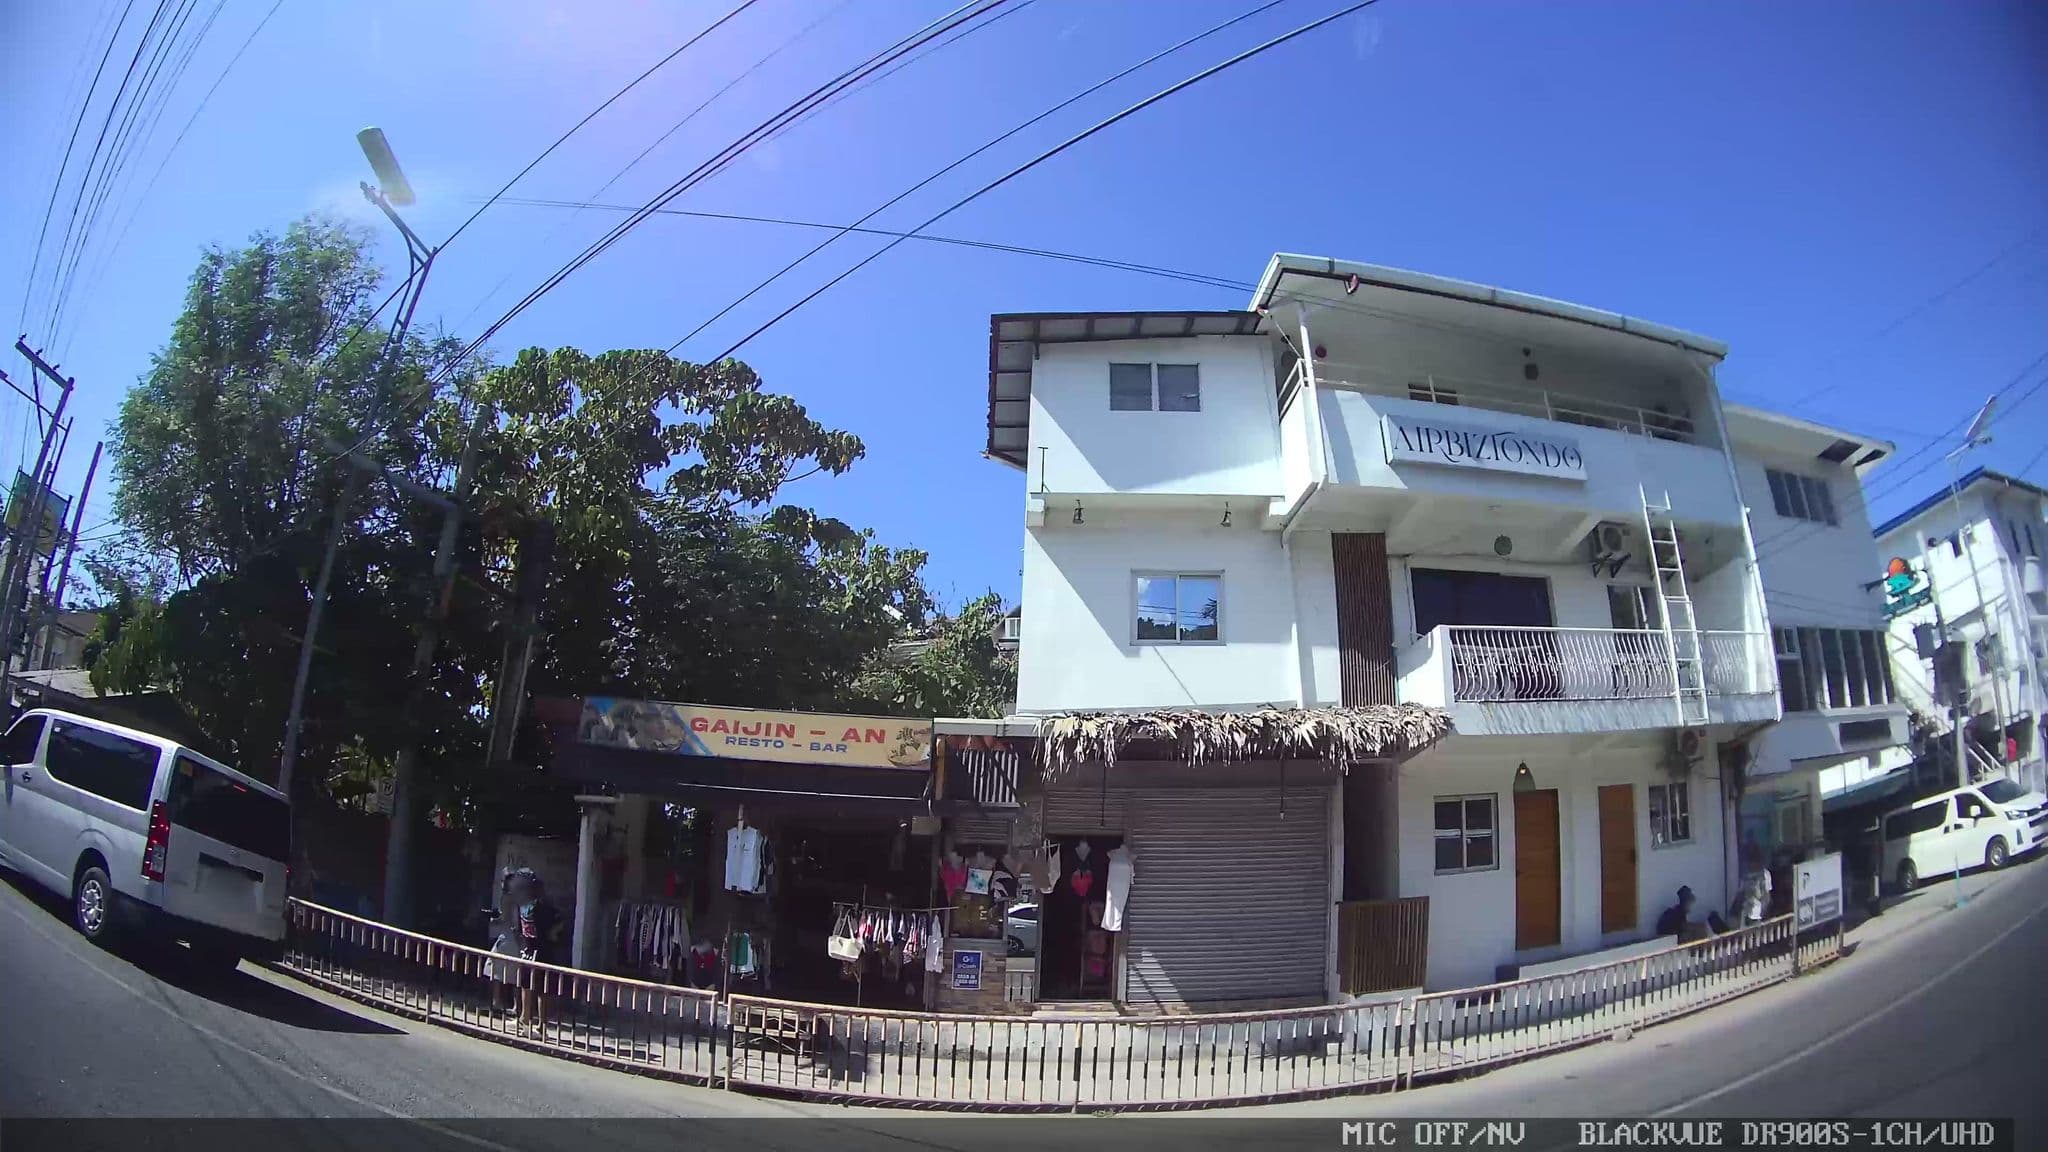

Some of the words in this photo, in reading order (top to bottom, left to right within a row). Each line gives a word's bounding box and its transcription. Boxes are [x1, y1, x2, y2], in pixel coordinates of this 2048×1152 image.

[1394, 425, 1582, 470] AIRBIZTONDO
[690, 717, 796, 738] GAIJIN
[841, 727, 886, 744] AN
[725, 735, 785, 749] RESTO
[809, 742, 848, 753] BAR
